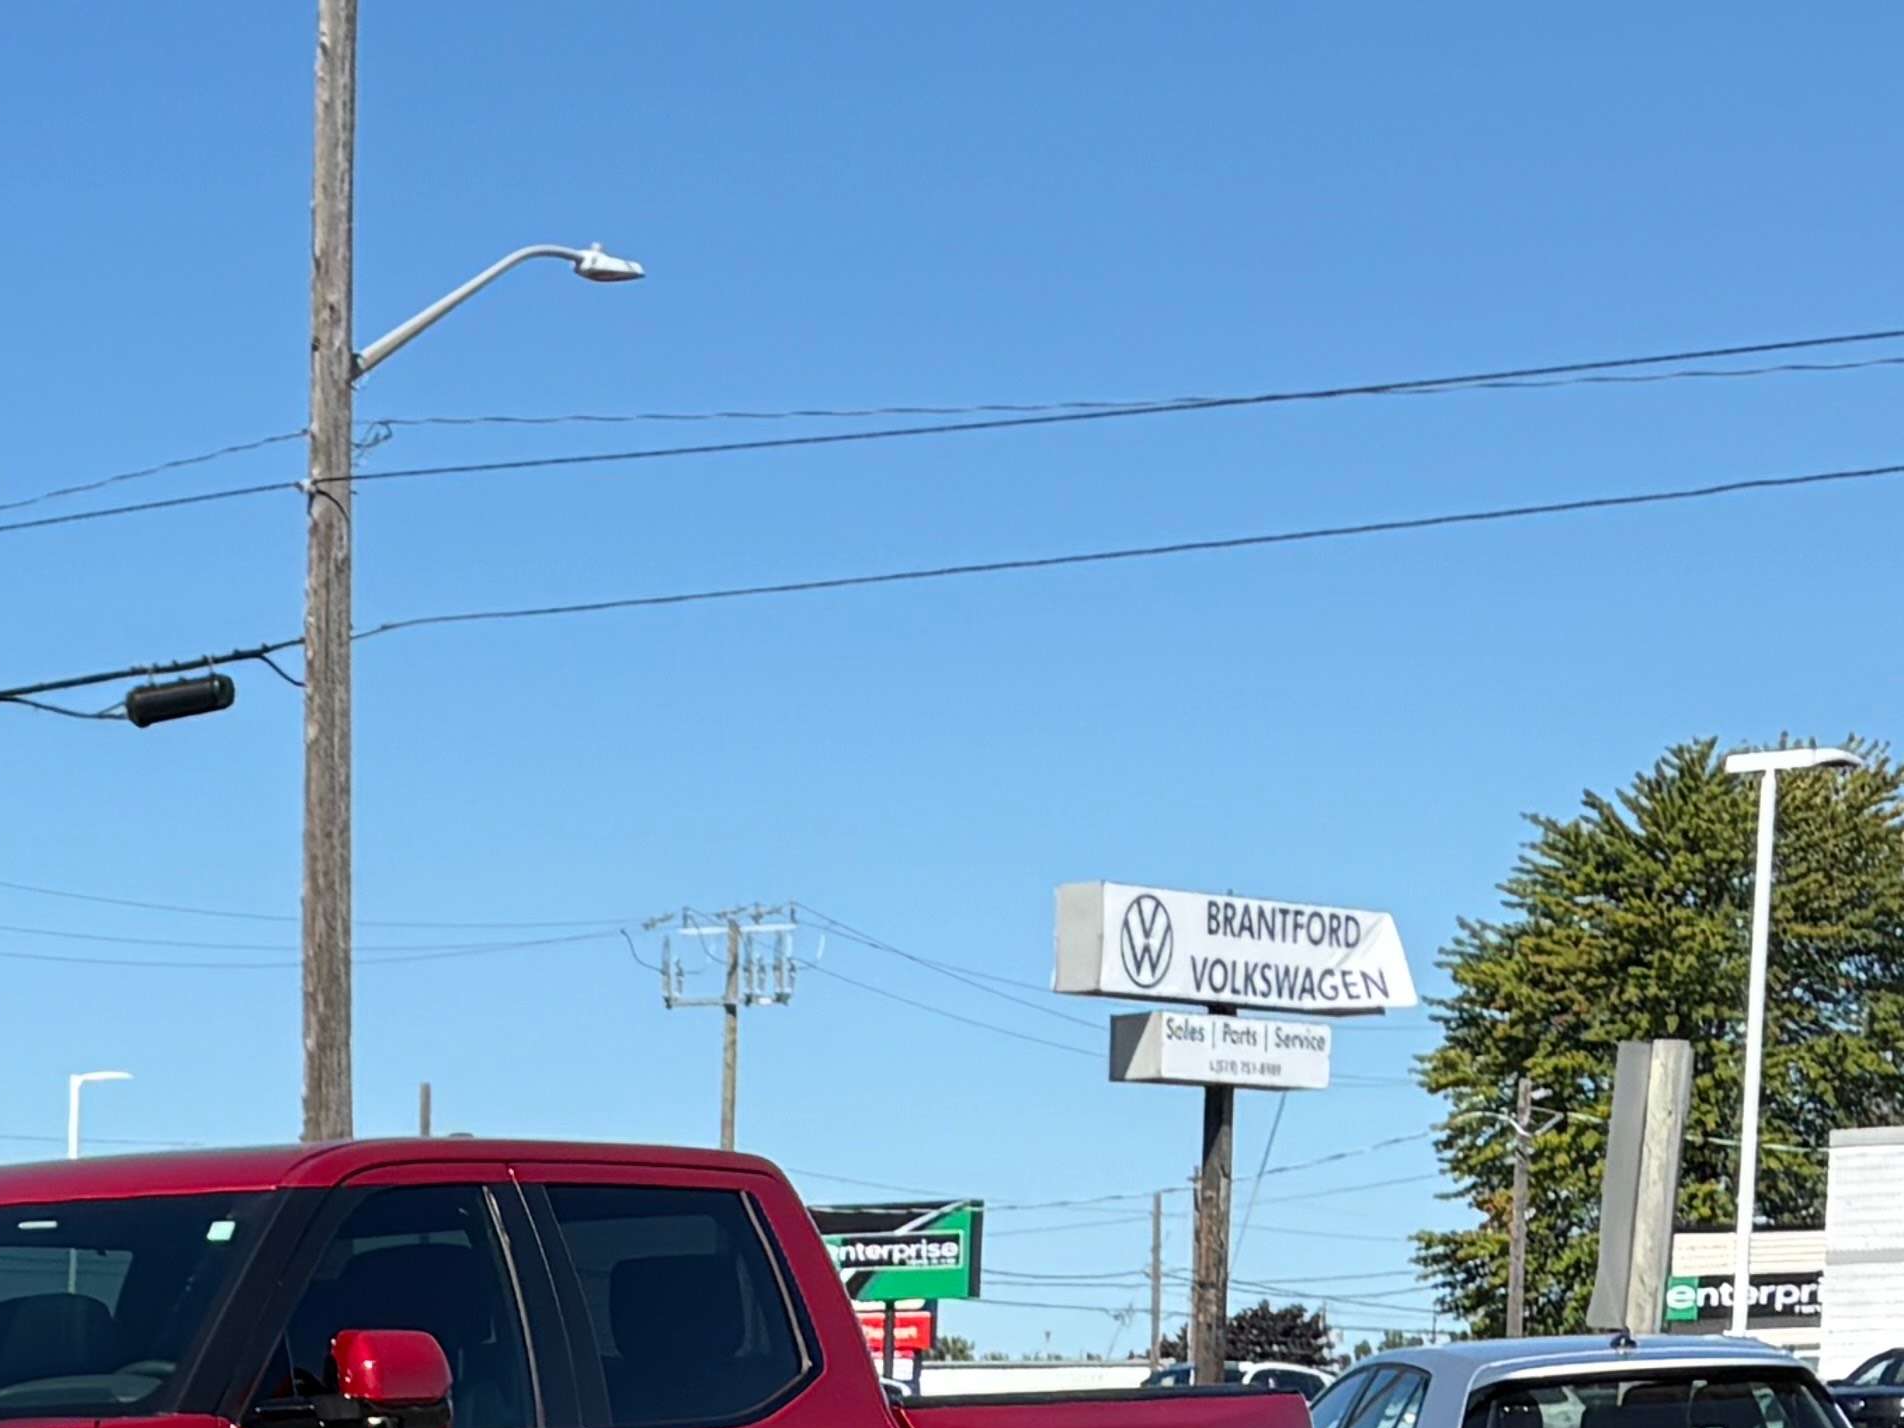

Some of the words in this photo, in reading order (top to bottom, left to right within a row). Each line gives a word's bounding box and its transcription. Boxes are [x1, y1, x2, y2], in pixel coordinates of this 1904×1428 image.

[1207, 900, 1360, 949] BRANTFORD
[1190, 956, 1390, 1001] VOLKSWAGEN
[1166, 1017, 1204, 1042] Sales
[1222, 1022, 1257, 1047] Parts
[1275, 1026, 1326, 1052] Service
